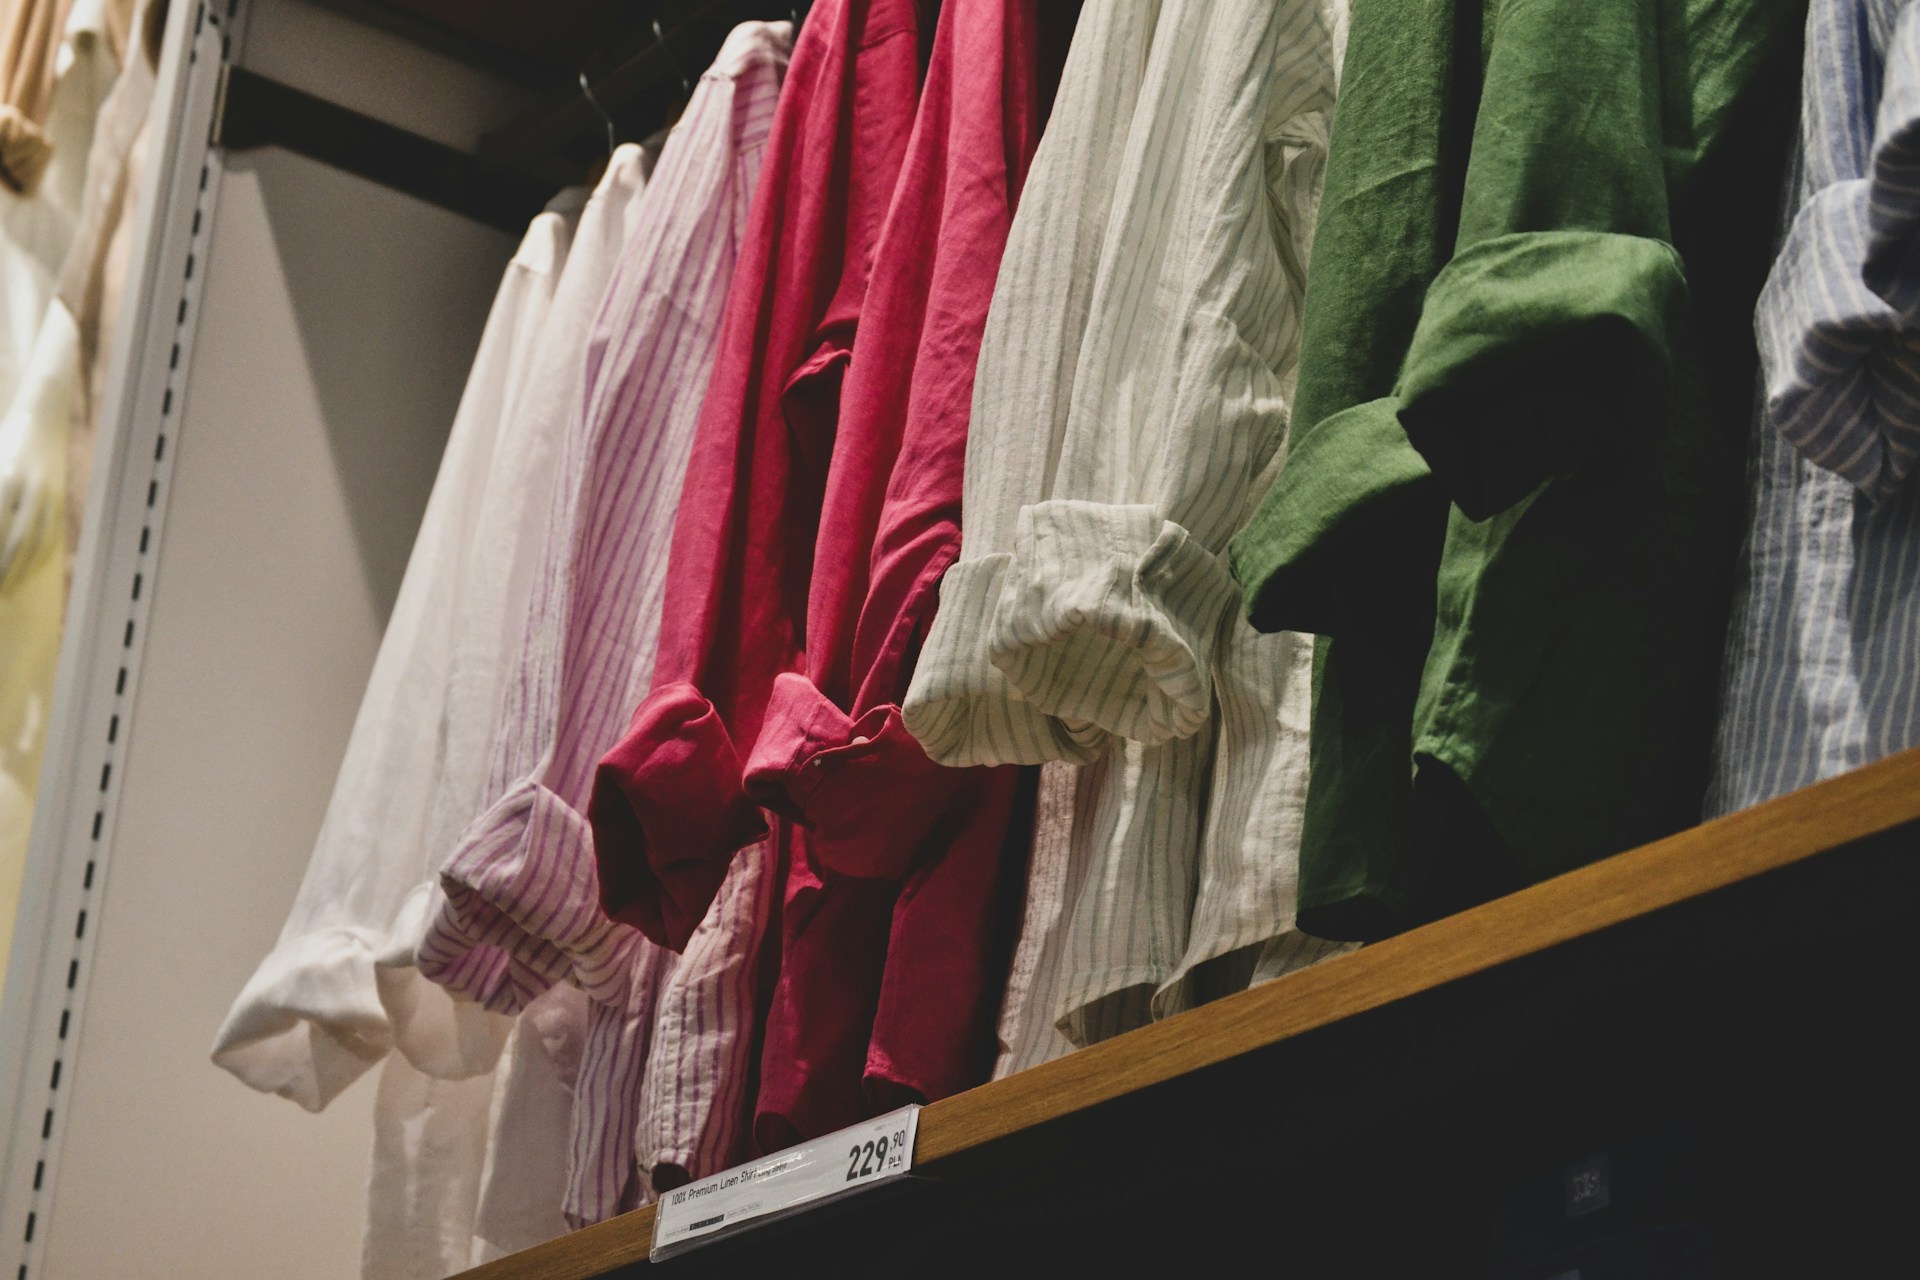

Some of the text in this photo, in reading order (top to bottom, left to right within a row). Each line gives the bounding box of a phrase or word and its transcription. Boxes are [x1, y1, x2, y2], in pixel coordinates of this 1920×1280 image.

[846, 1136, 888, 1182] 229
[672, 1191, 686, 1206] 100%
[688, 1183, 718, 1200] Premium
[720, 1176, 738, 1190] Linen
[741, 1168, 757, 1183] Shirt
